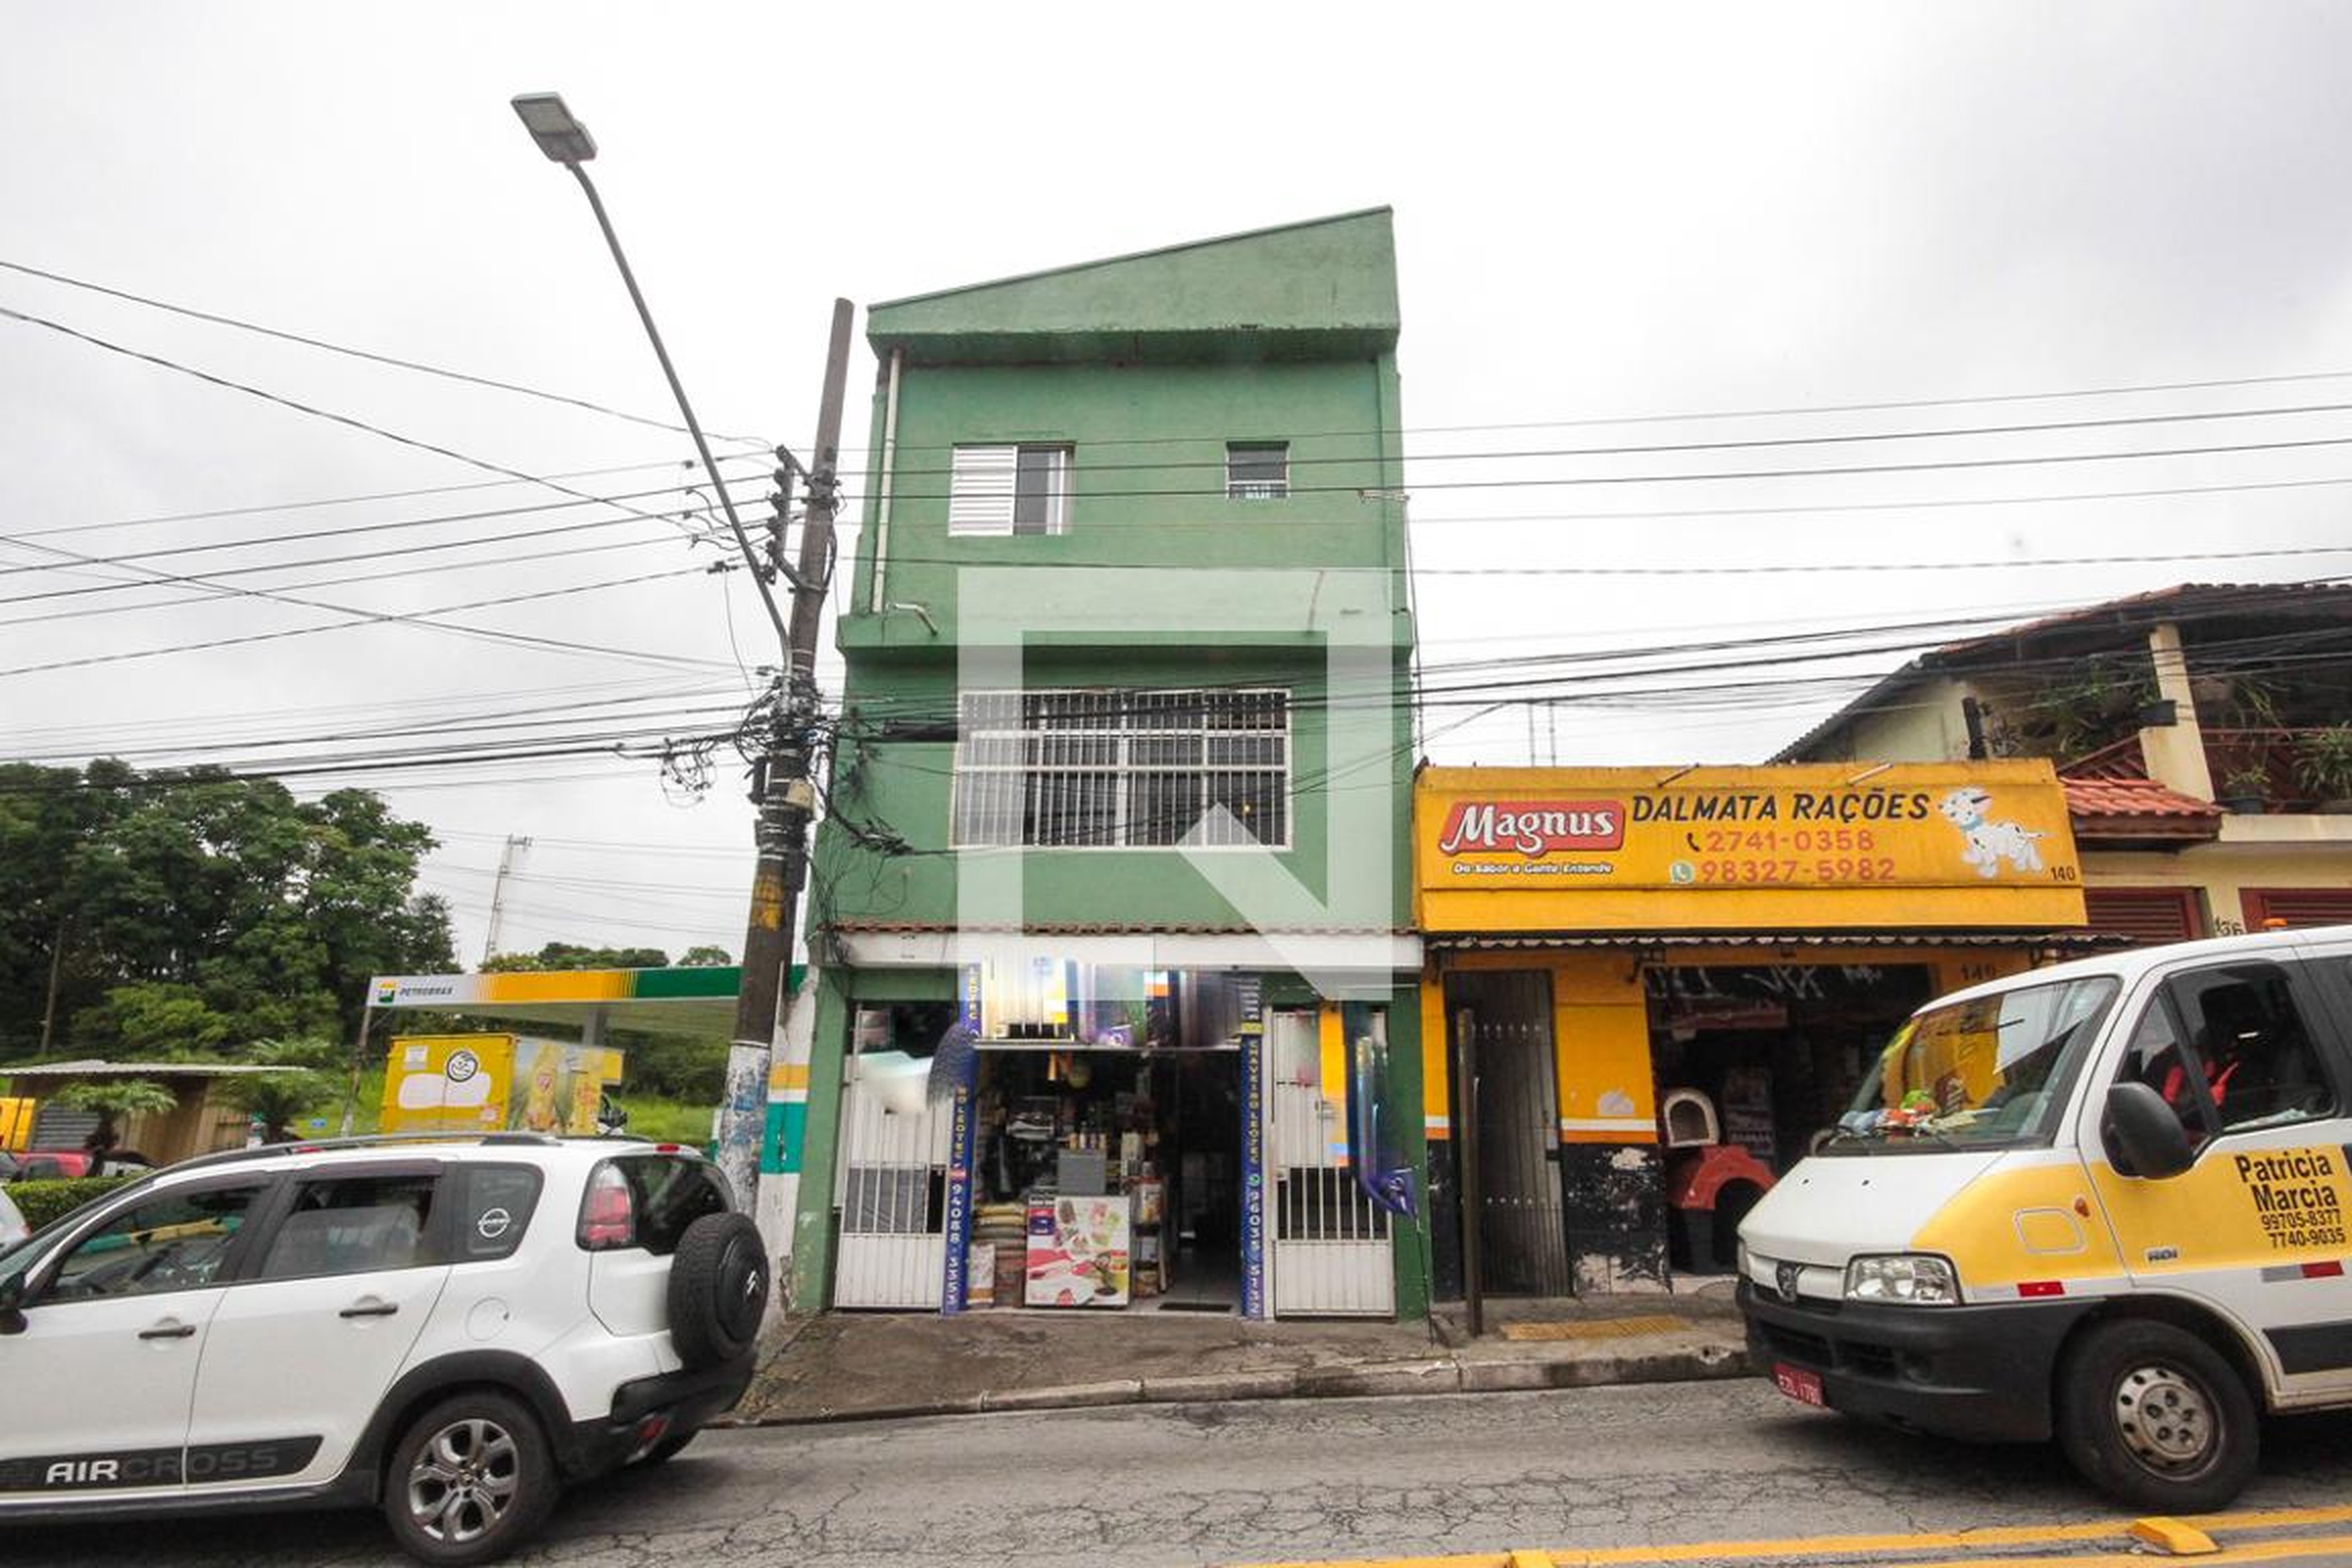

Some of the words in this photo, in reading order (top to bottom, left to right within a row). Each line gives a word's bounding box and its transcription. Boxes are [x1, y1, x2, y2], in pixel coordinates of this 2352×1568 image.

[1632, 795, 1777, 822] DALMATA
[1792, 788, 1930, 824] RAÇÕES
[1440, 805, 1615, 854] Magnus
[1705, 830, 1875, 853] 2741-0358
[1701, 858, 1896, 883] 98327-5982
[2051, 865, 2076, 881] 140
[2235, 1150, 2332, 1182] Patricia
[2251, 1180, 2337, 1212] Marcia
[2269, 1227, 2346, 1248] 7740-9035
